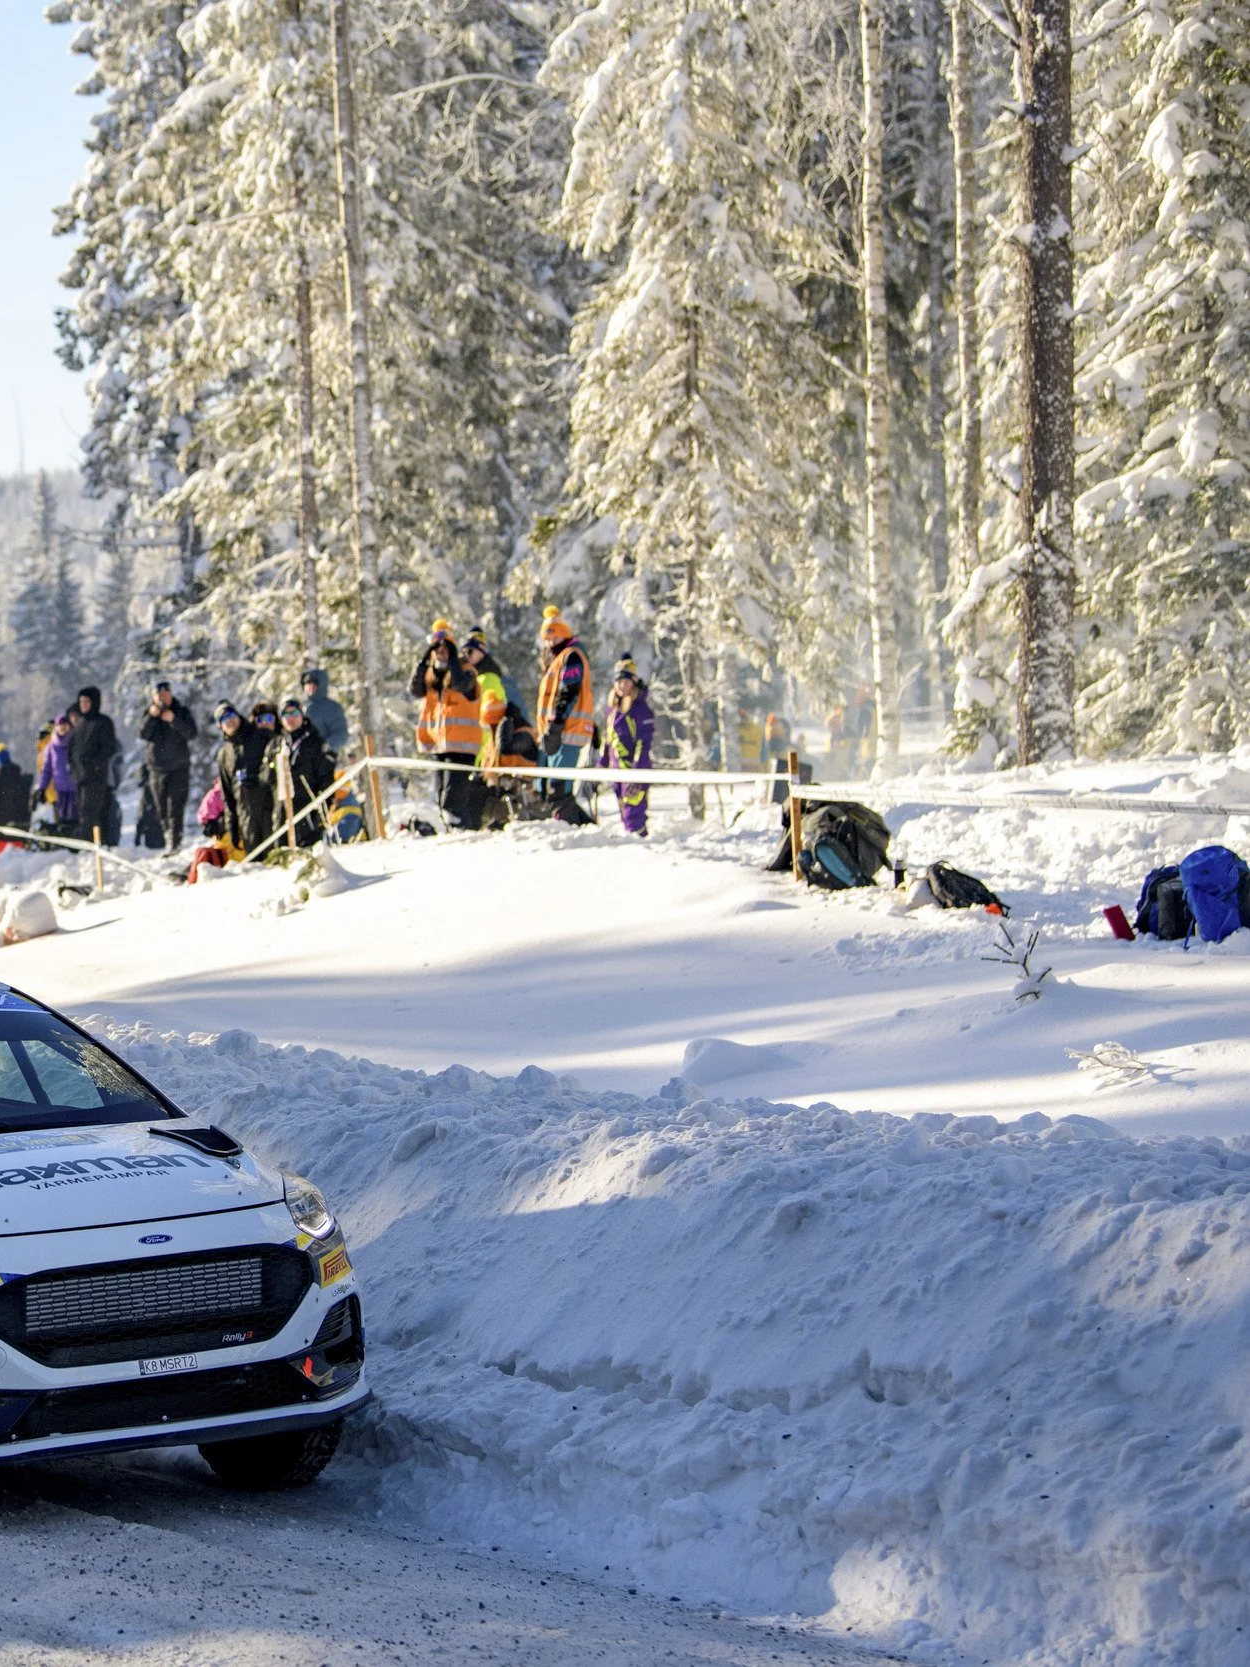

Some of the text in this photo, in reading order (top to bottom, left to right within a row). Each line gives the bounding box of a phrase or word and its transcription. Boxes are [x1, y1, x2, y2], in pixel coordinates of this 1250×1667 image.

[29, 1168, 170, 1192] VÄRMEPUMPAR
[322, 1248, 349, 1282] PIRELLI
[144, 1355, 195, 1373] K8 MSRT2
